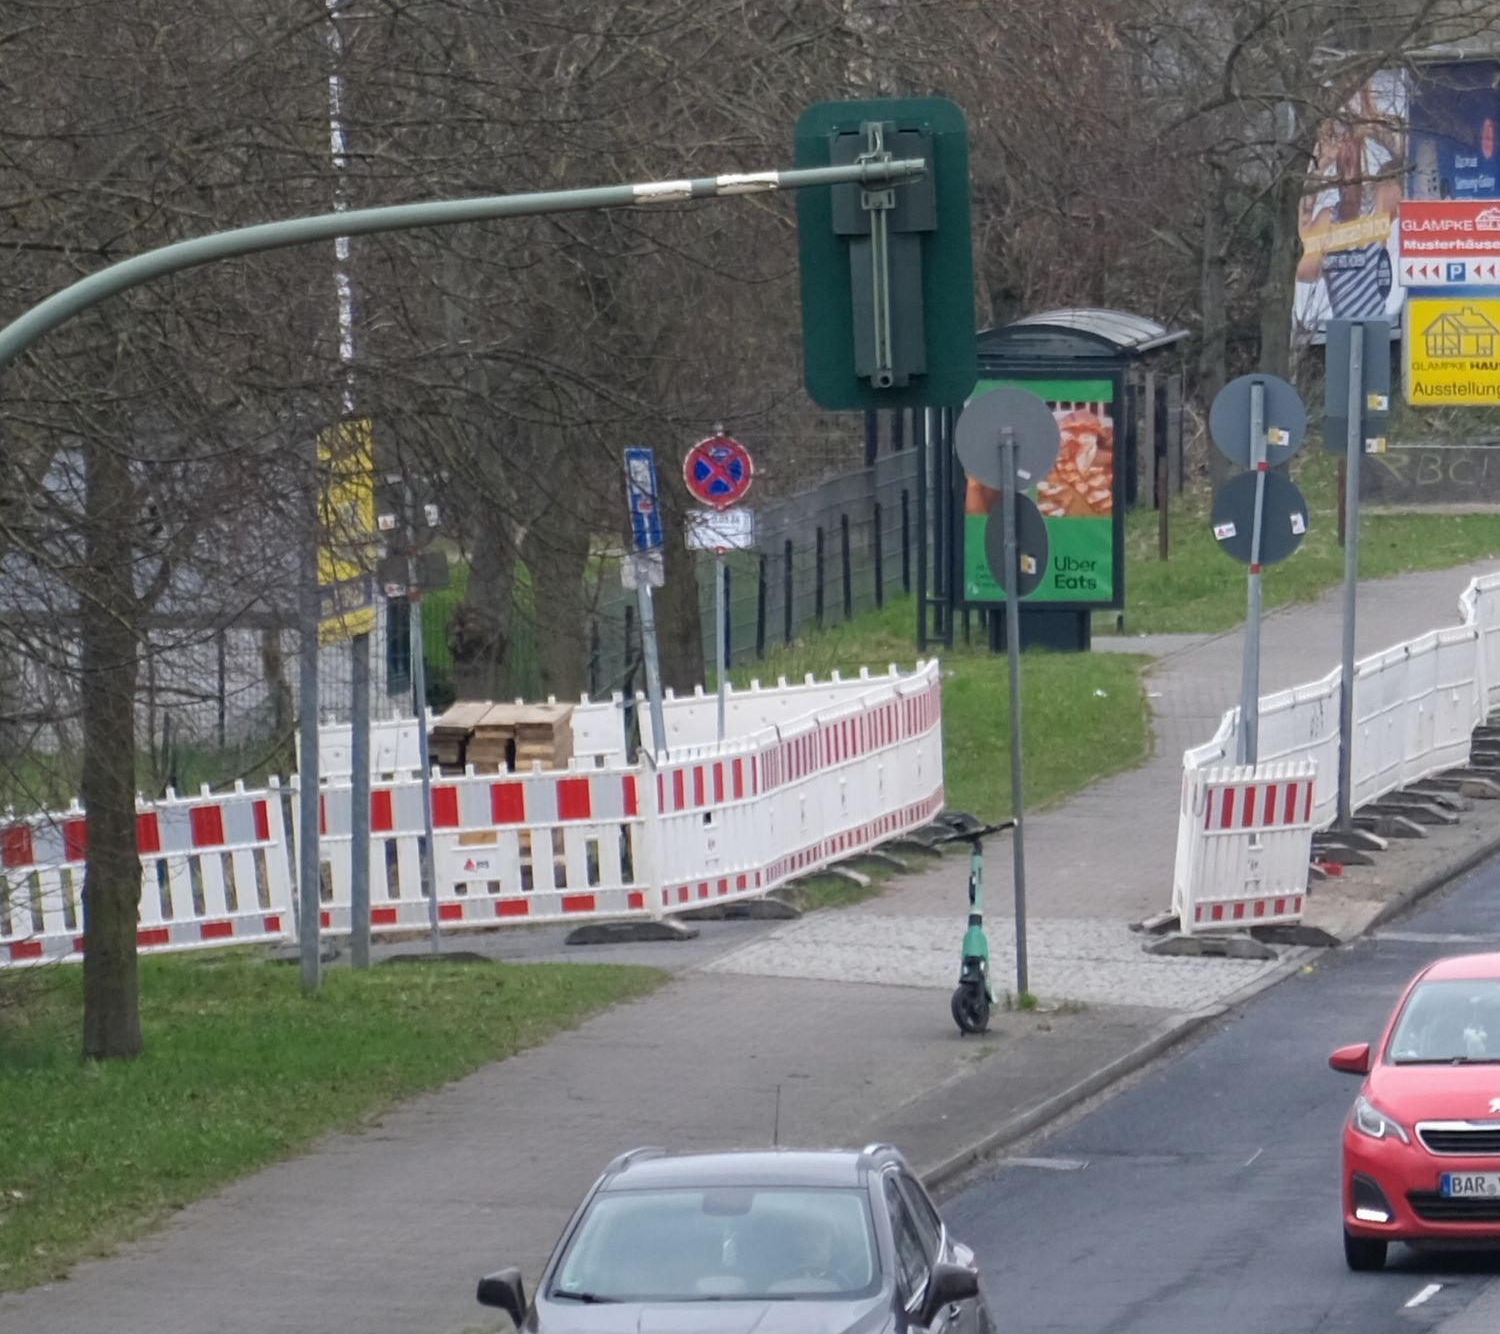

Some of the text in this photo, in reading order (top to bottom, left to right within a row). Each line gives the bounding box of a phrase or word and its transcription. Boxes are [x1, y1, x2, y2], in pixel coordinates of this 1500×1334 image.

[1402, 219, 1473, 232] GLAMPKE
[1054, 556, 1097, 572] Uber
[1054, 574, 1097, 591] Eats
[1452, 1176, 1486, 1194] BAR
